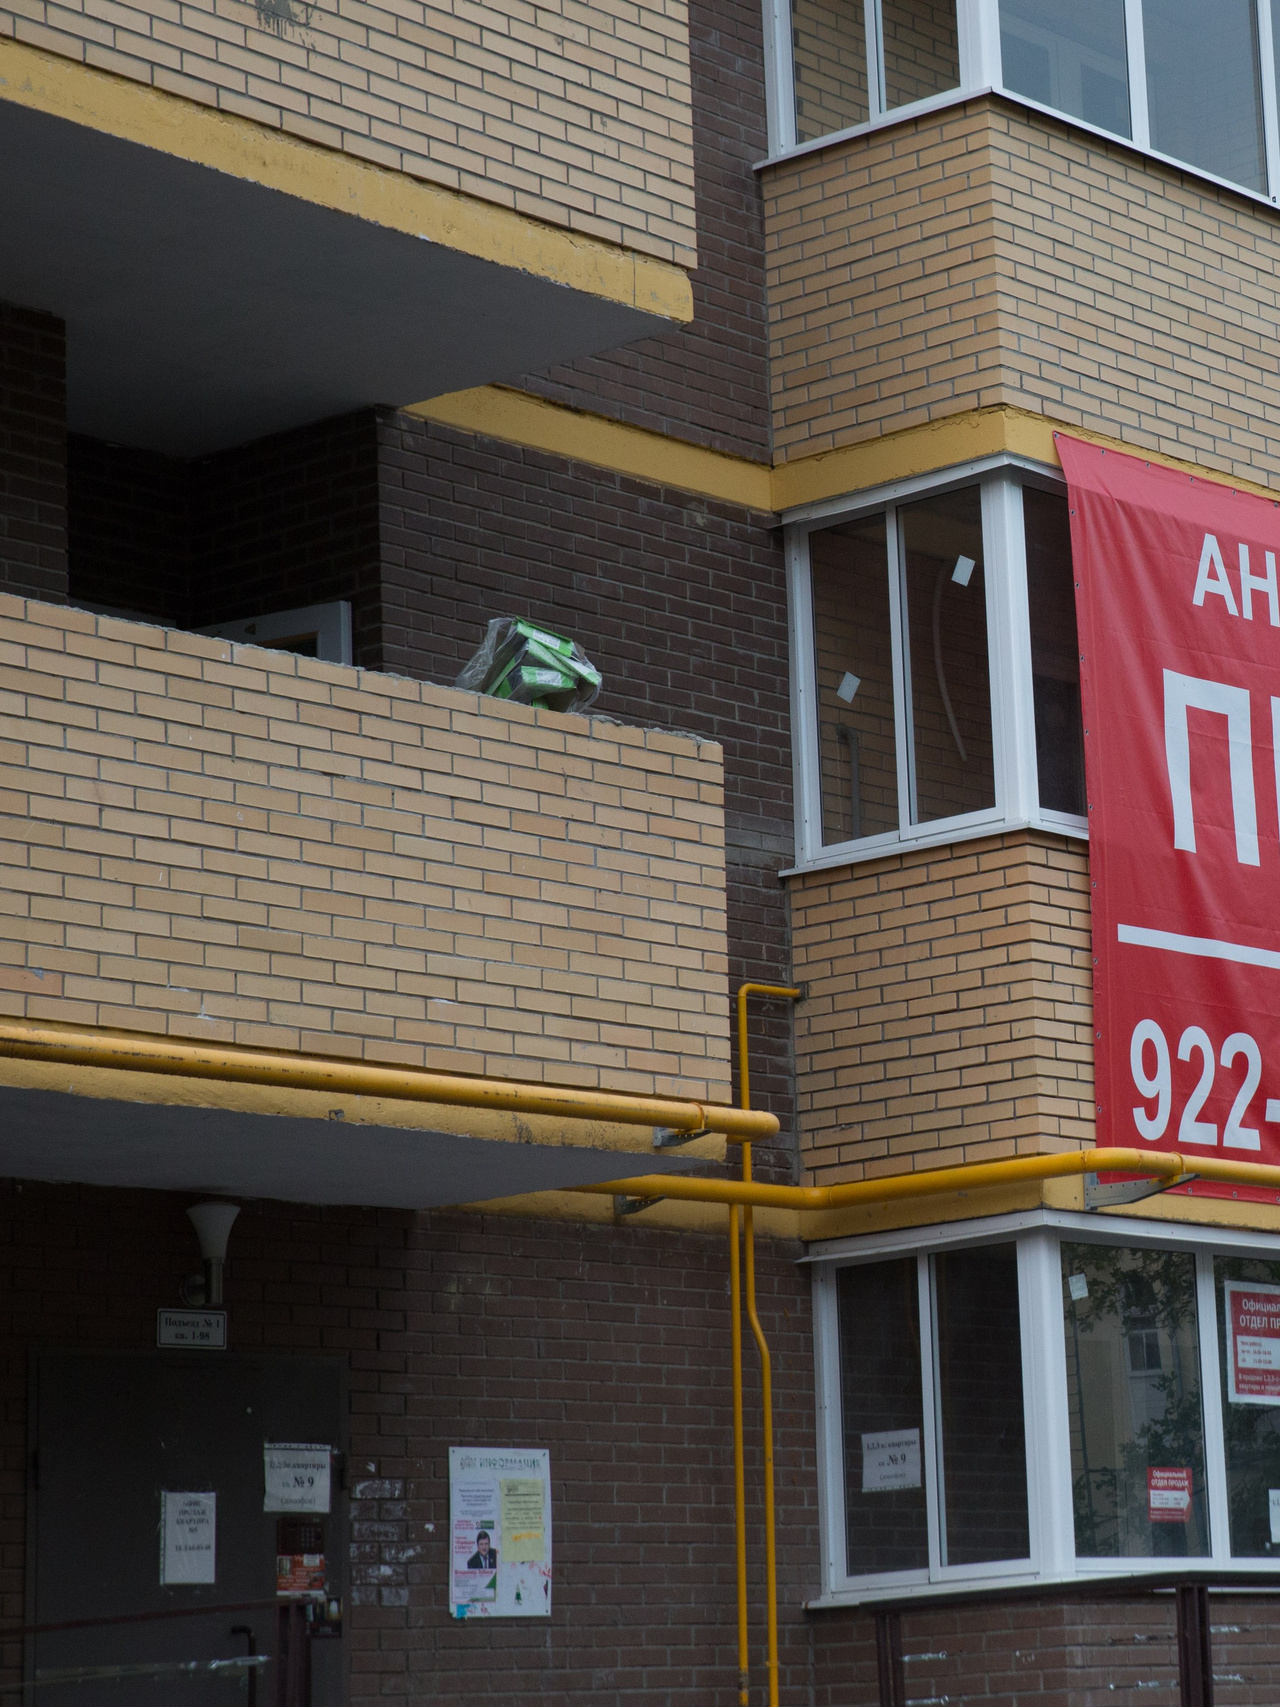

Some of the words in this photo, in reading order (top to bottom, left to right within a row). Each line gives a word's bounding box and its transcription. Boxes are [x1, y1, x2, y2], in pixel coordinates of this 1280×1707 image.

[1192, 533, 1280, 628] АН
[1240, 1314, 1268, 1330] ОТДЕЛ
[307, 1475, 315, 1488] 9
